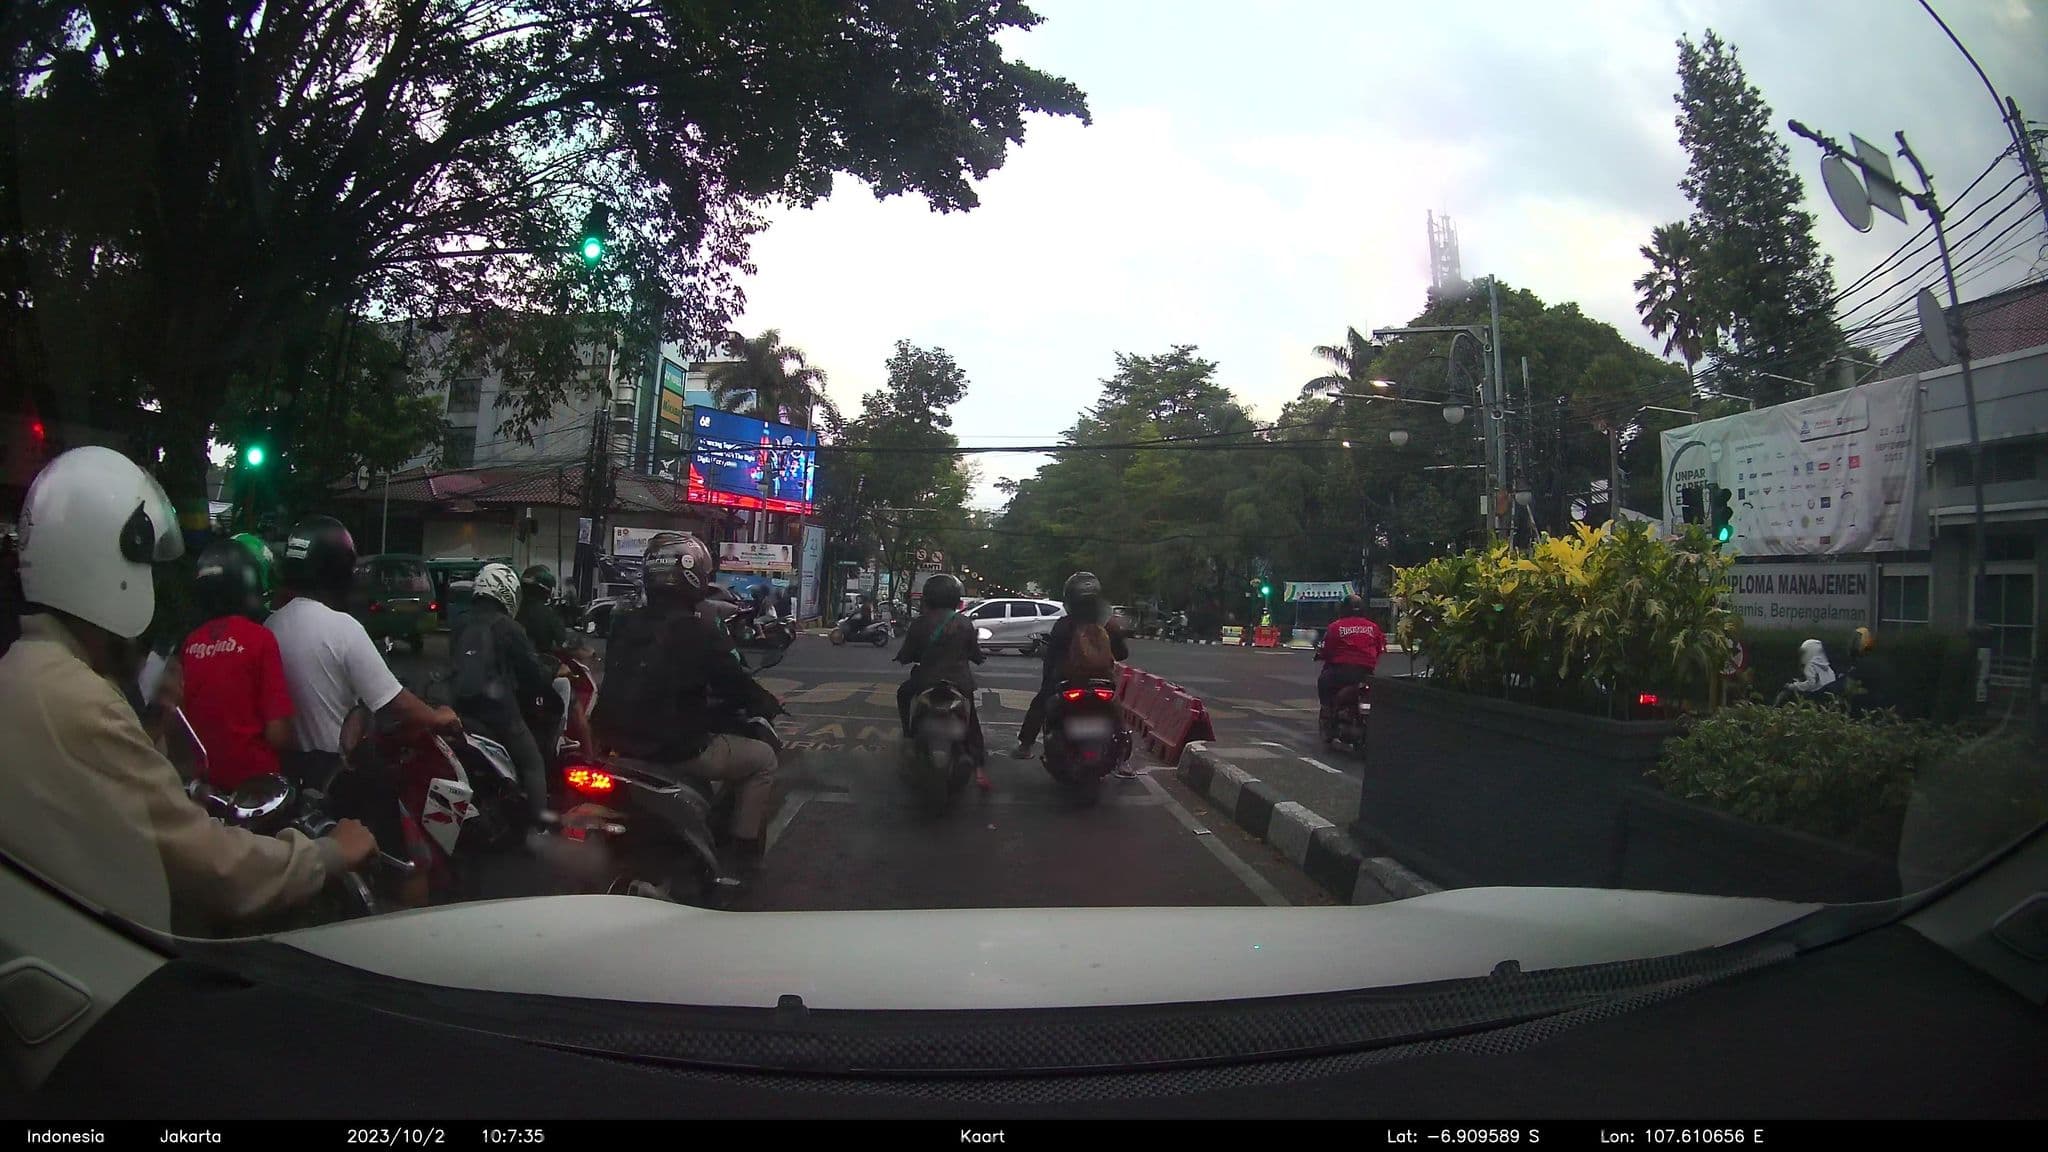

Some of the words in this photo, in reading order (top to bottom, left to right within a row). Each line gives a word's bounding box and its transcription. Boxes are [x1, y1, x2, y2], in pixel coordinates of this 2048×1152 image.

[1675, 468, 1706, 481] UNPAR
[1778, 573, 1867, 595] MANAJEMEN
[1770, 603, 1866, 623] Berpengalaman
